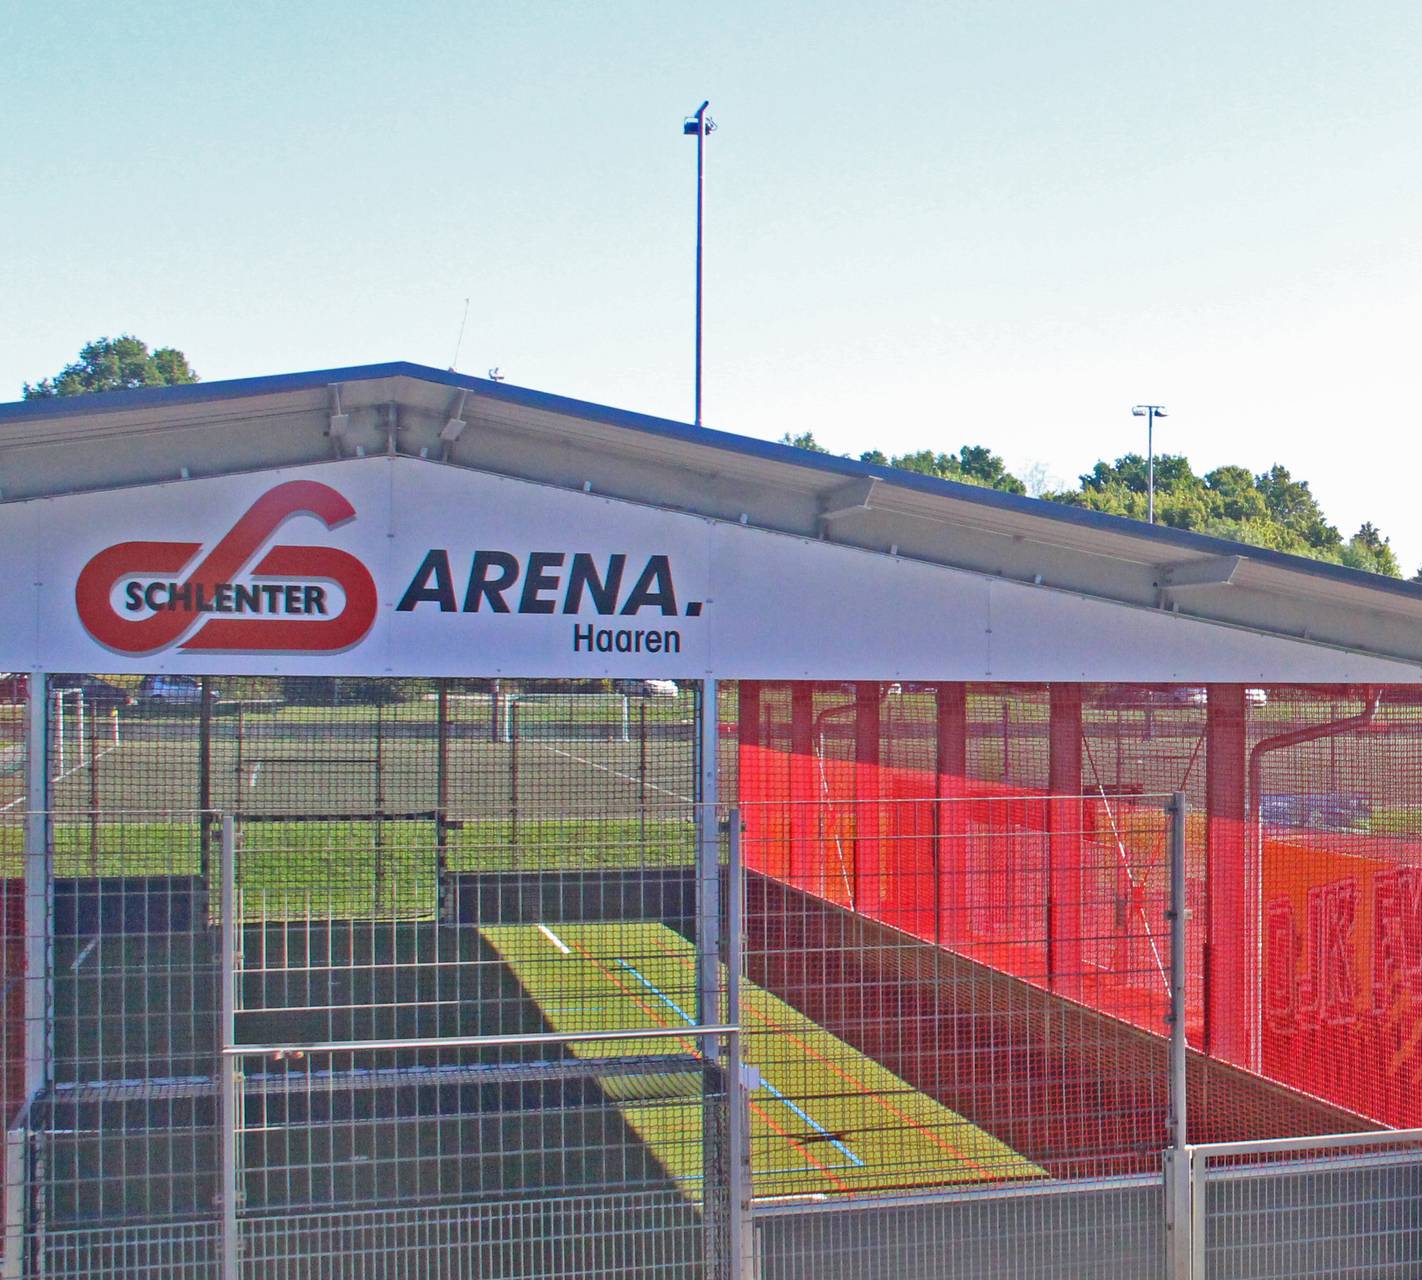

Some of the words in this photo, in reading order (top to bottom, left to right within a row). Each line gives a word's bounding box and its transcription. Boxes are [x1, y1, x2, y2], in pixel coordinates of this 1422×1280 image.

[125, 581, 327, 615] SCHLENTER
[395, 549, 703, 617] ARENA.
[573, 623, 681, 653] Haaren
